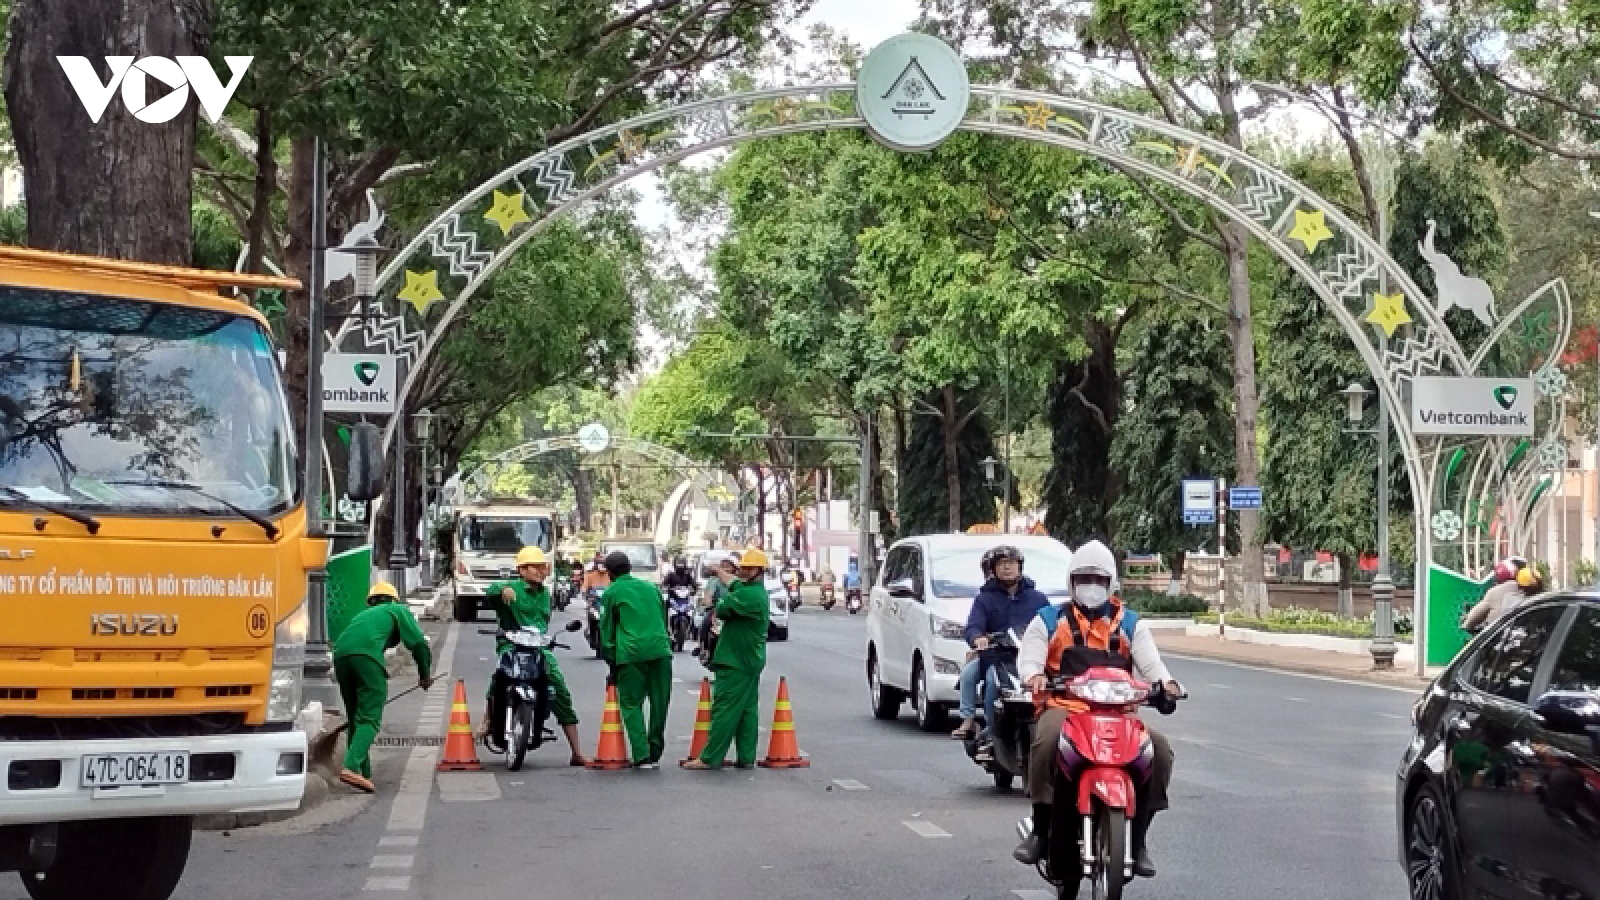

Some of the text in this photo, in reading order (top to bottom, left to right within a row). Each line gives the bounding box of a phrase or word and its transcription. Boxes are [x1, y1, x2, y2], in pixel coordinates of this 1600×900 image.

[321, 386, 388, 402] ombank
[1420, 410, 1528, 426] Vietcombank
[19, 576, 36, 594] TY
[39, 566, 56, 594] CỔ
[116, 576, 135, 598] THỊ
[91, 614, 178, 636] ISUZU
[251, 613, 266, 631] 06
[86, 754, 185, 782] 47C-064.18
